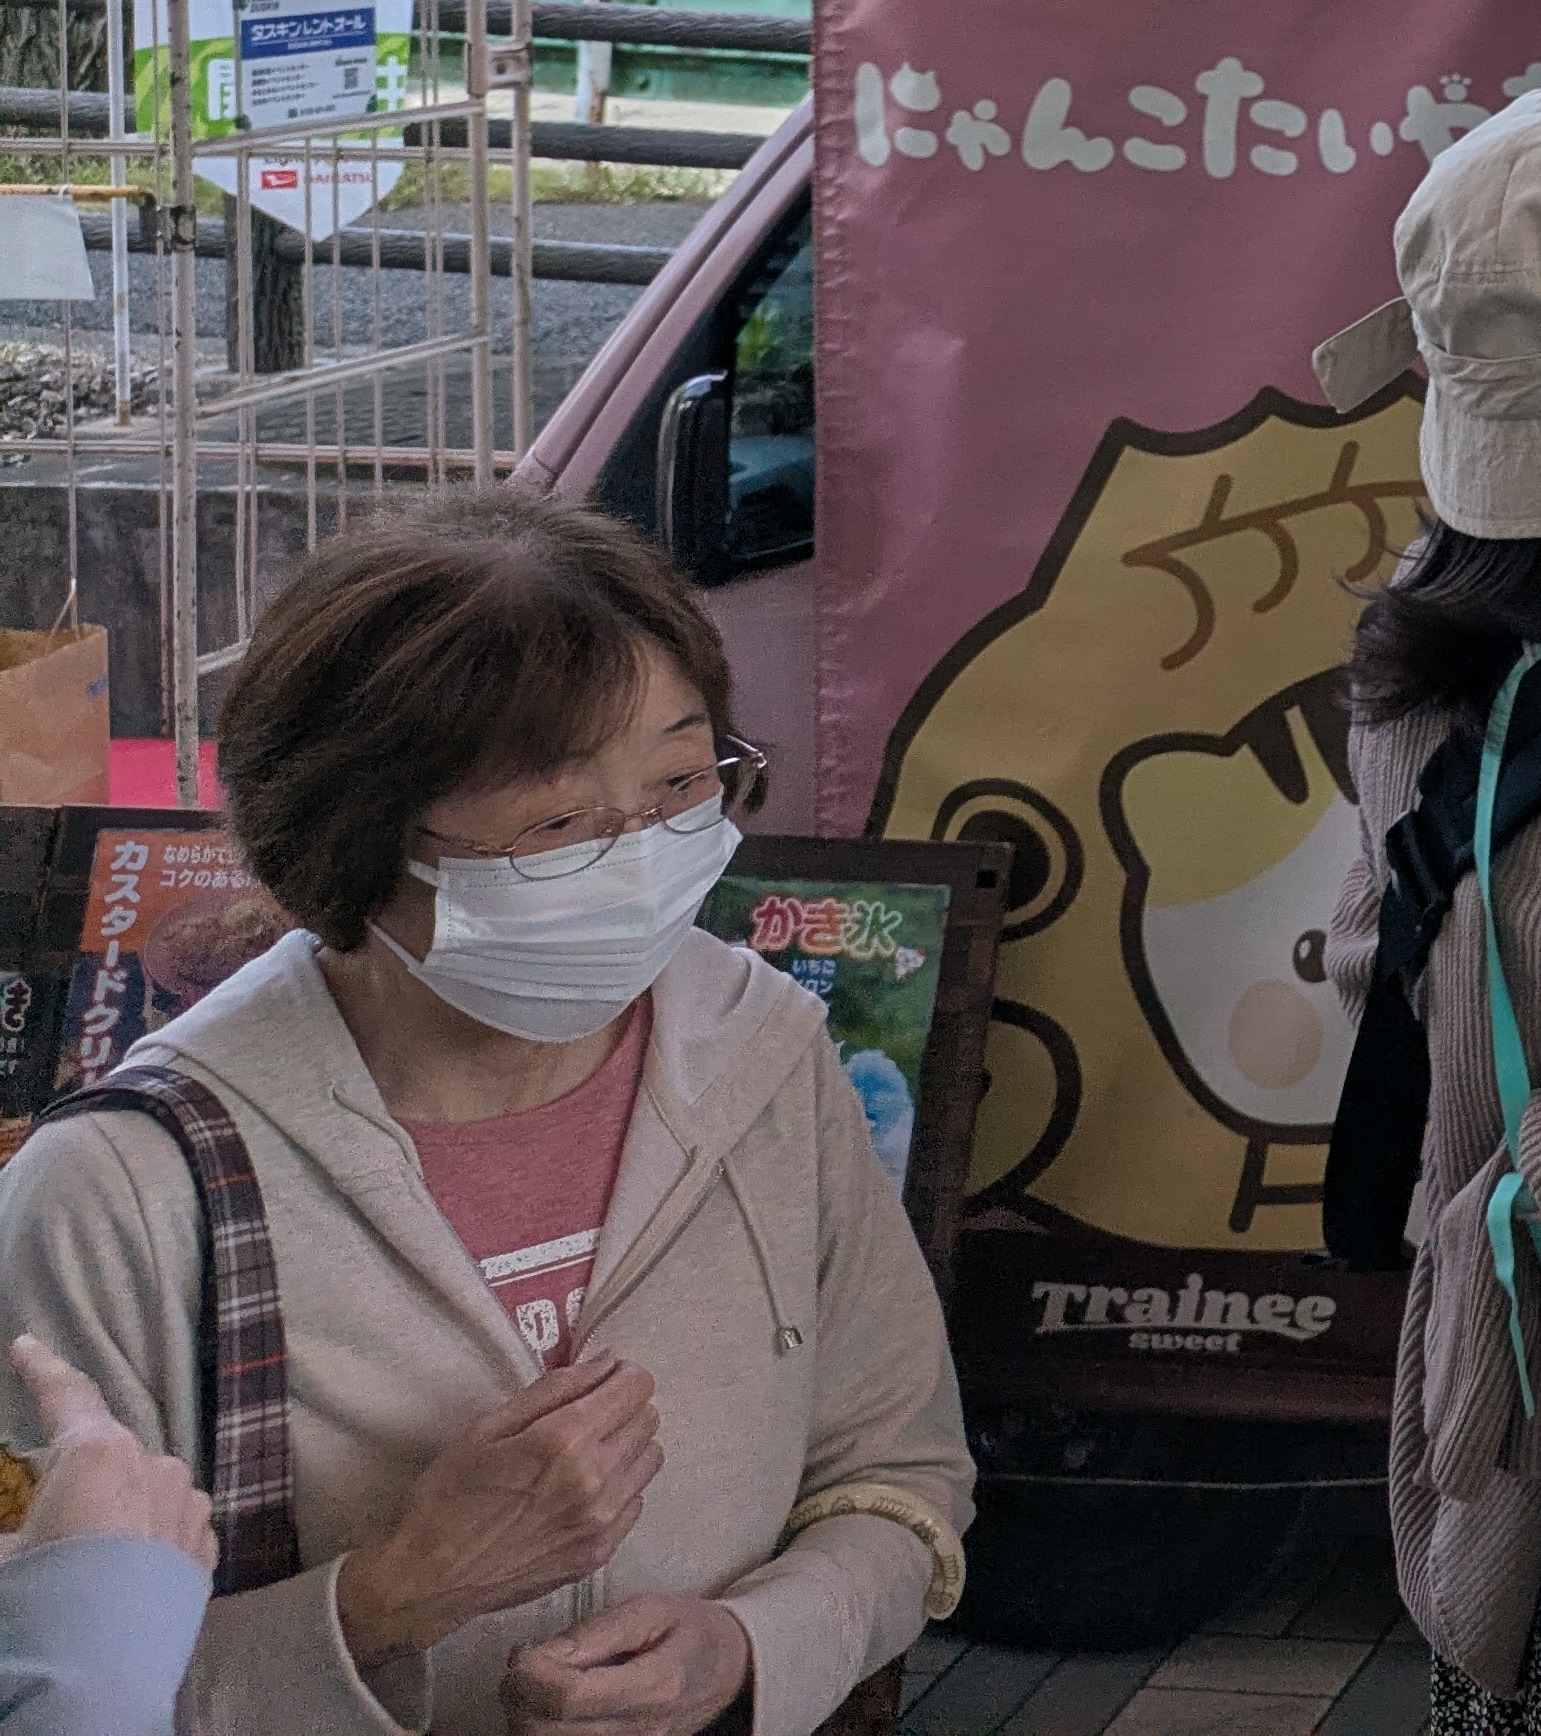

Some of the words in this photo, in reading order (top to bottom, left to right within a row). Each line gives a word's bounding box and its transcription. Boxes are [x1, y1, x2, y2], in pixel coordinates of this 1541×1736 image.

[752, 895, 903, 960] かき氷
[791, 958, 837, 976] いちご
[798, 978, 834, 995] ロン
[1030, 1271, 1338, 1342] Trainee
[1127, 1331, 1244, 1354] sweet
